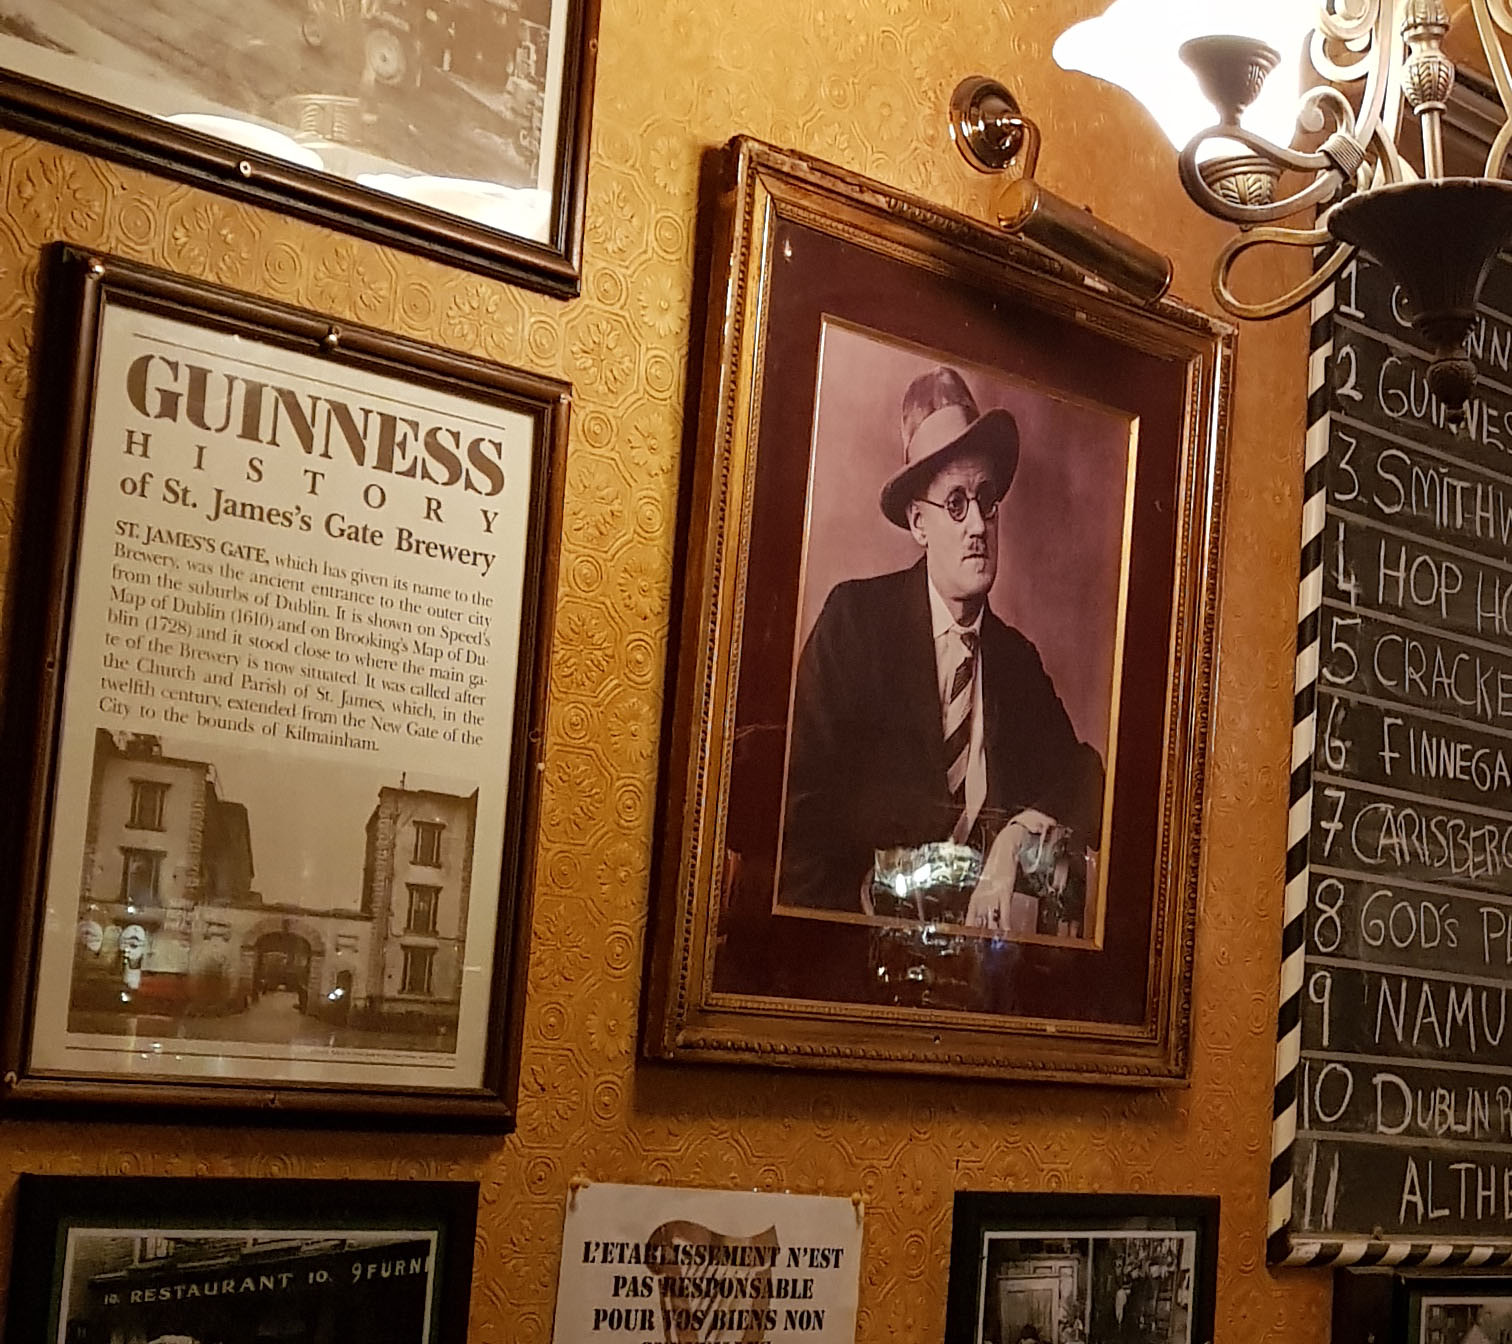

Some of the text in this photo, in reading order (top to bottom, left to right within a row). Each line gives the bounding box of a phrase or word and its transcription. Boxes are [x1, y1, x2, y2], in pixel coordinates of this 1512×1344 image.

[1340, 259, 1366, 319] 1
[1336, 344, 1365, 402] 2
[126, 353, 506, 497] GUINNESS
[122, 428, 501, 535] HISTORY
[1334, 431, 1360, 502] 3
[119, 471, 498, 578] of St. James's Gate Brewery
[114, 519, 494, 608] ST. JAMES'S GATE, which has given its name to the
[186, 560, 214, 576] was
[219, 562, 245, 581] the
[249, 572, 305, 593] ancient
[311, 581, 376, 606] entrance
[379, 594, 395, 609] to
[399, 596, 423, 614] the
[426, 605, 464, 623] outer
[467, 610, 493, 629] city
[1378, 538, 1463, 619] HOP
[112, 562, 491, 647] from the suburbs of Dublin. It is shown on Speed's
[1321, 615, 1363, 685] 5
[1324, 697, 1349, 772] 6
[1320, 787, 1346, 859] 7
[1313, 877, 1346, 954] 8
[1307, 969, 1332, 1048] 9
[1303, 1058, 1354, 1131] 10
[1302, 1139, 1341, 1232] 11
[130, 1272, 295, 1305] RESTAURANT
[581, 1240, 845, 1270] L'ETABLISSEMENT N'EST
[611, 1275, 815, 1302] PAS RESPONSABLE
[592, 1308, 827, 1332] POUR VOS BIENS NON
